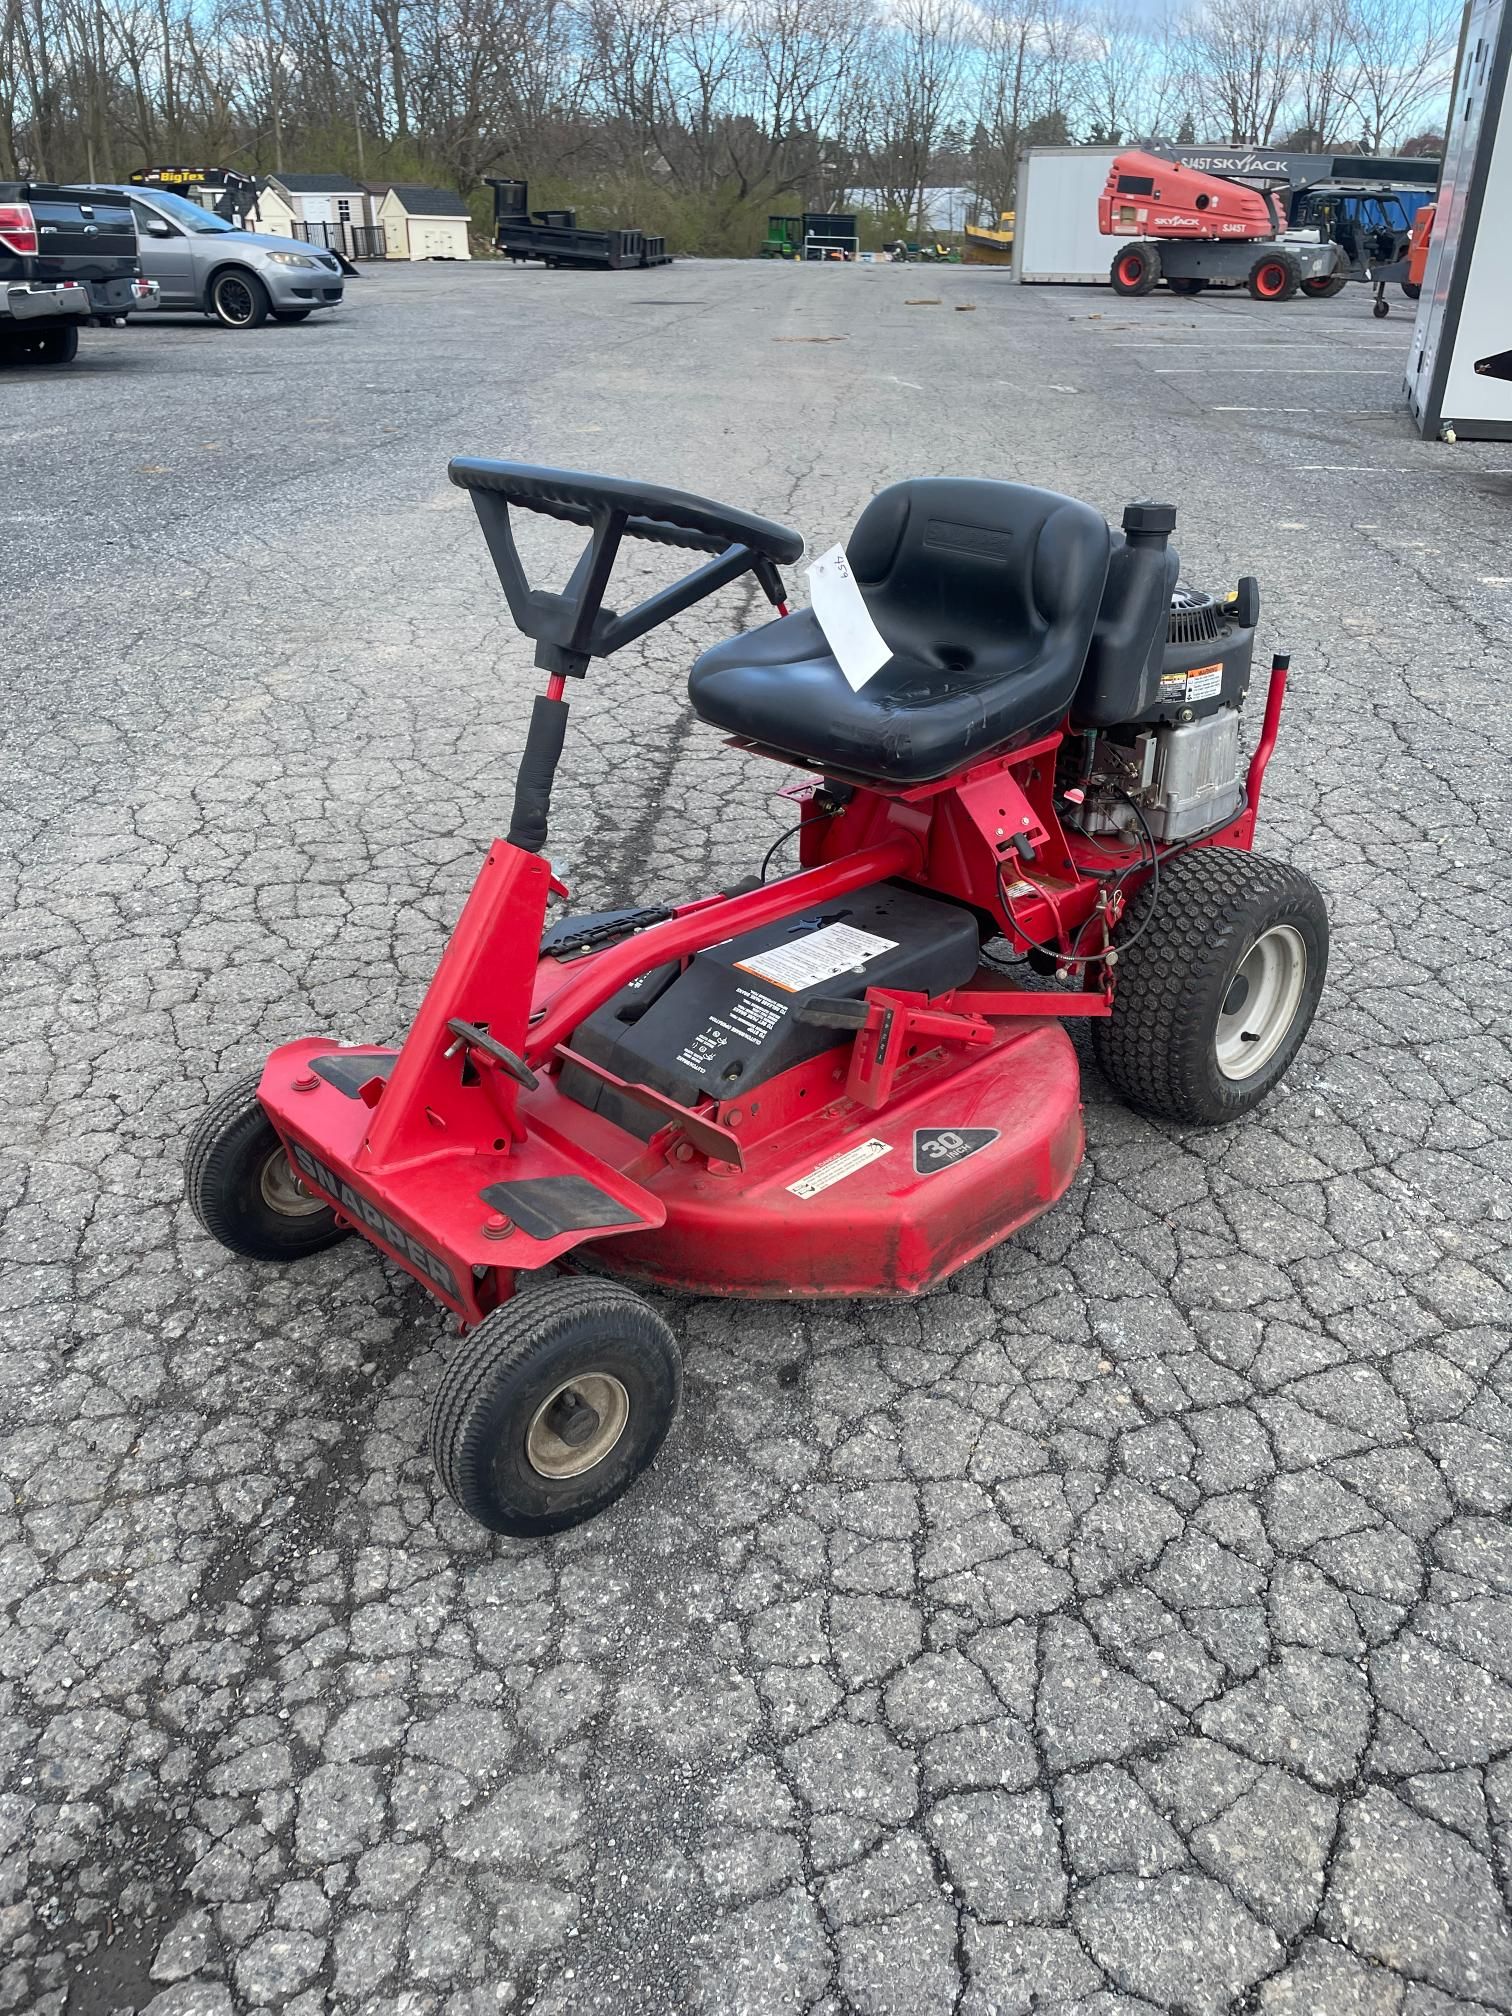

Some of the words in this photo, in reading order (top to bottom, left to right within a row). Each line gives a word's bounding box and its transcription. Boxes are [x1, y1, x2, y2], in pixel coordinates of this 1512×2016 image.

[1180, 157, 1211, 171] SJ45T
[1212, 155, 1288, 173] SKYJACK
[1154, 215, 1200, 227] SKYJACK
[1222, 223, 1246, 233] SJ45T
[834, 556, 849, 579] 459
[921, 1131, 964, 1158] 30
[946, 1143, 972, 1159] INCH
[293, 1145, 456, 1296] SNAPPER
